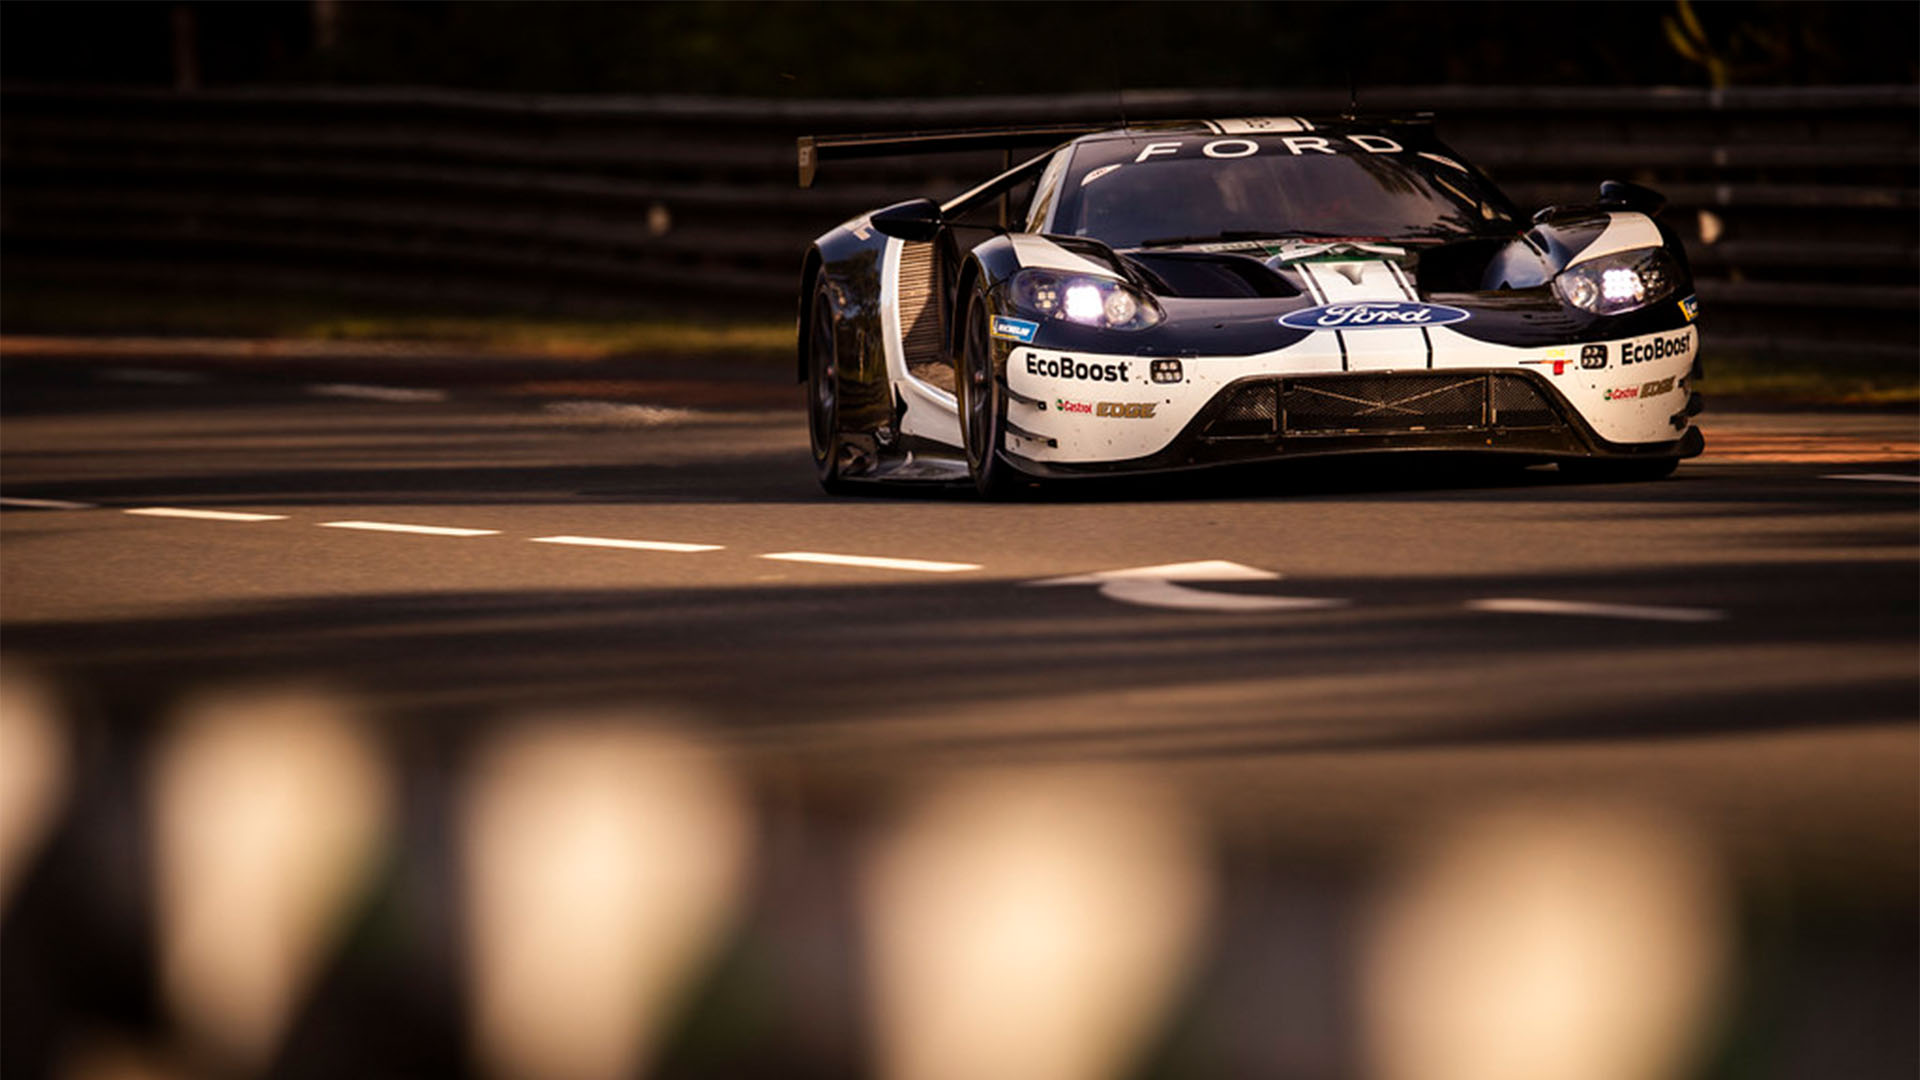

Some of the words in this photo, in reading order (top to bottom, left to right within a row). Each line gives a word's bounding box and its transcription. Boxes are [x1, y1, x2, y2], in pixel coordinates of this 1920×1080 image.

[1135, 135, 1404, 163] FORD
[1621, 335, 1690, 365] EcoBoost
[1026, 353, 1129, 382] EcoBoost
[1063, 400, 1093, 414] Castrol
[1095, 402, 1160, 418] EDGE
